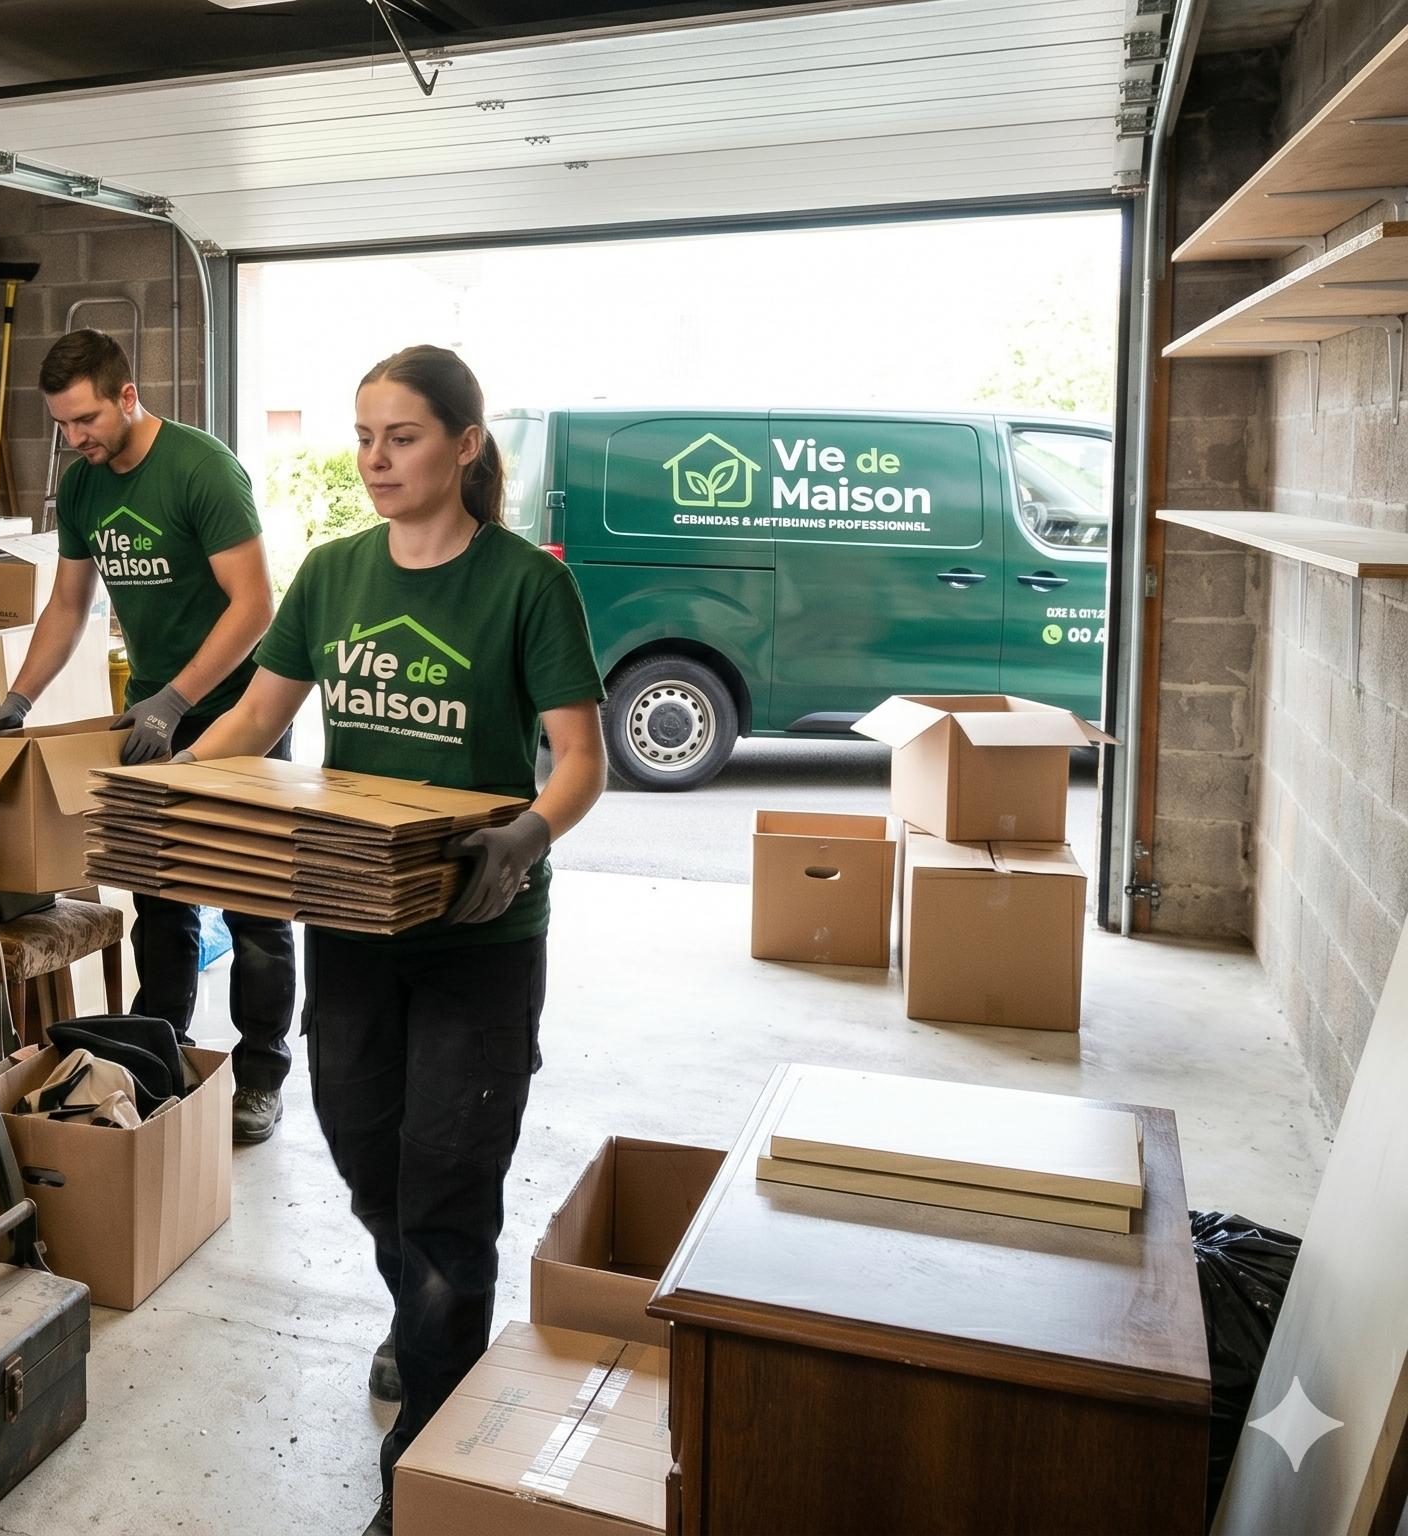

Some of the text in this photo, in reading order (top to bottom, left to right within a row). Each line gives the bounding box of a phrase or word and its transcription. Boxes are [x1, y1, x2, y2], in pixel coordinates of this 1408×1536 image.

[771, 438, 901, 474] Vie de
[772, 476, 931, 514] Maison
[94, 528, 153, 553] Vie de
[93, 552, 170, 577] Maison
[337, 640, 448, 685] Vie de
[324, 678, 467, 729] Maison
